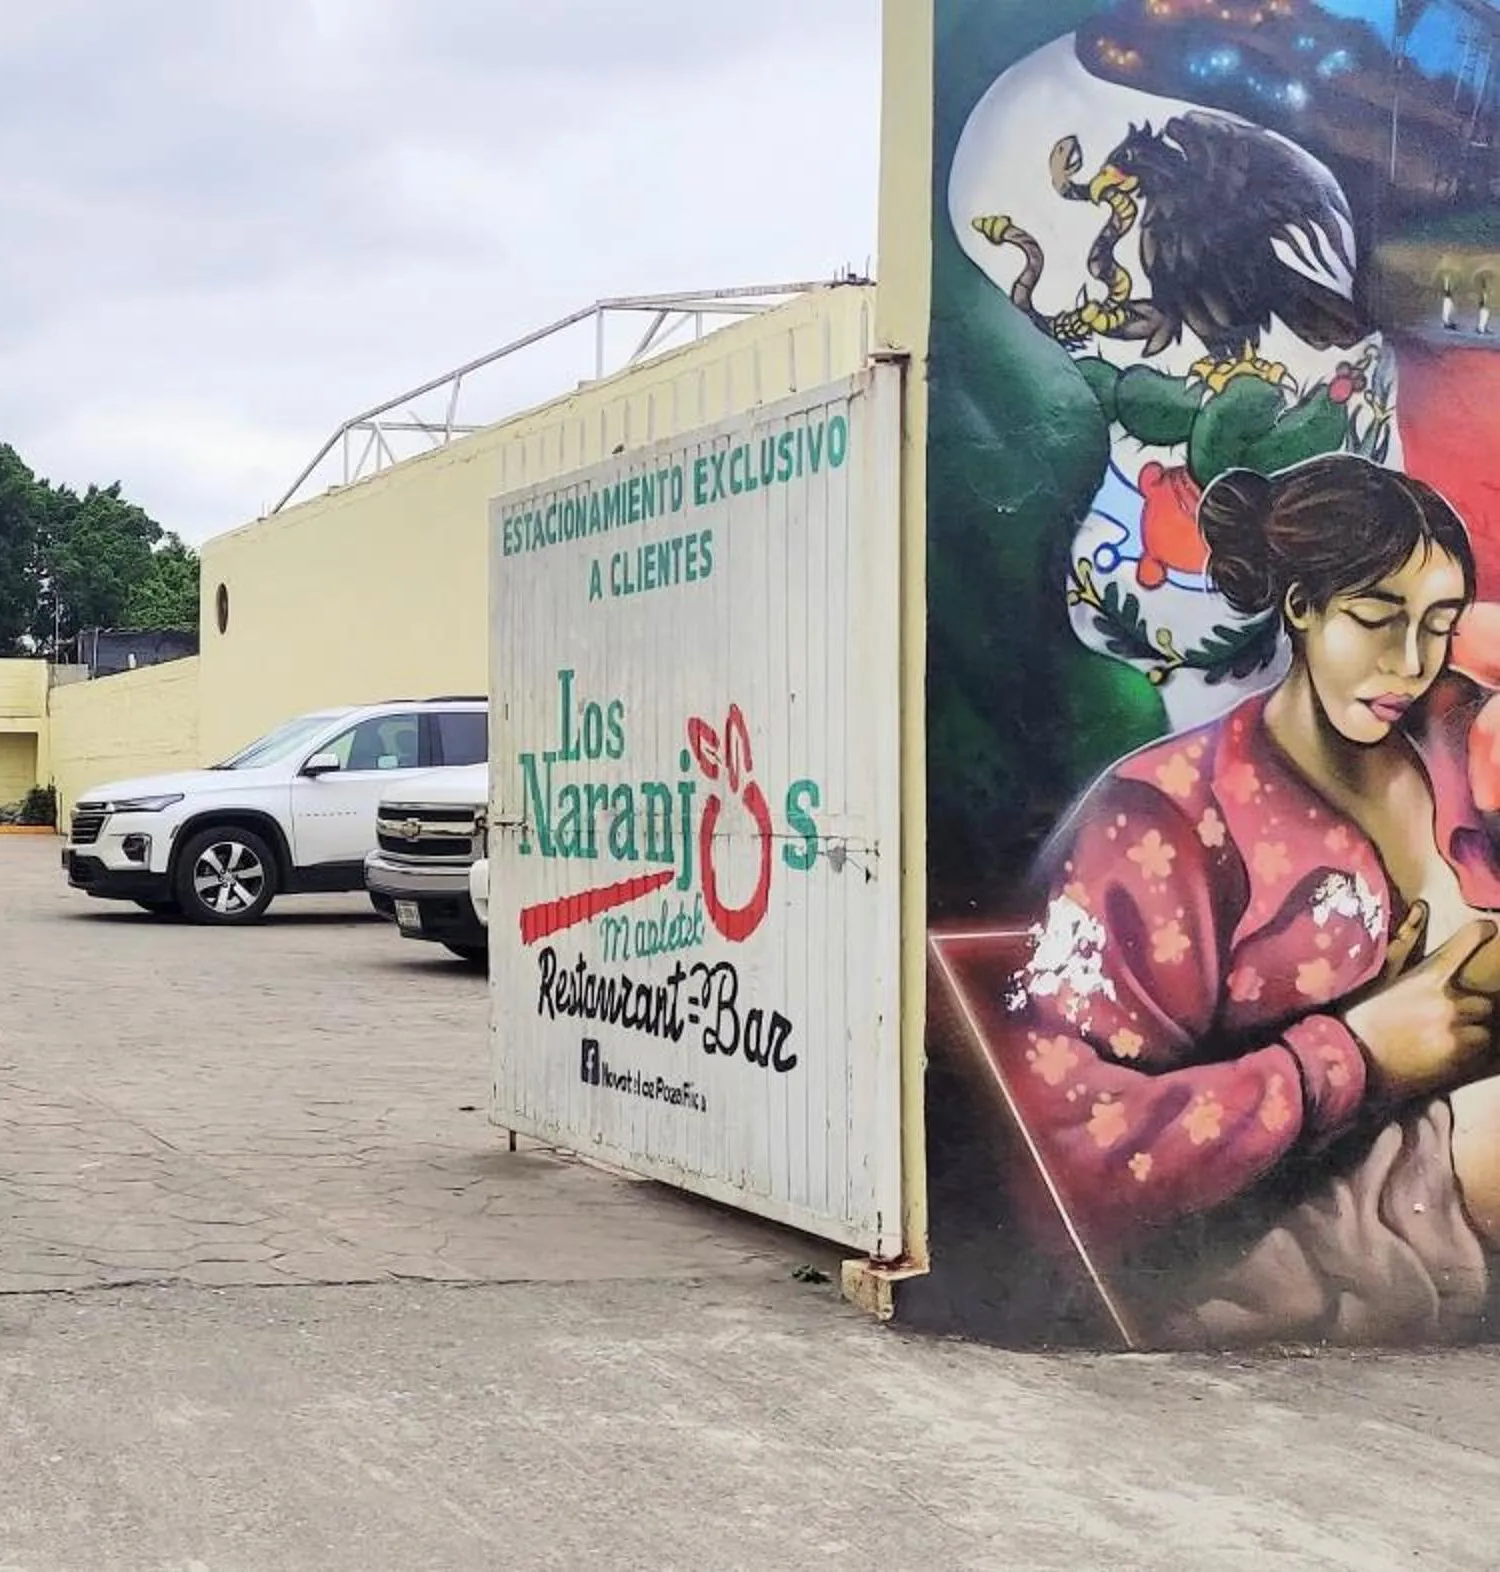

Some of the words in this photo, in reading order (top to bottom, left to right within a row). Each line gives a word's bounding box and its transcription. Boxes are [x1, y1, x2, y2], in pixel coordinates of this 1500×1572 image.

[502, 464, 684, 557] ESTACIONAMIENTO
[693, 414, 848, 506] EXCLUSIVO
[588, 558, 603, 602] A
[610, 528, 713, 597] CLIENTES
[556, 668, 625, 761] Los
